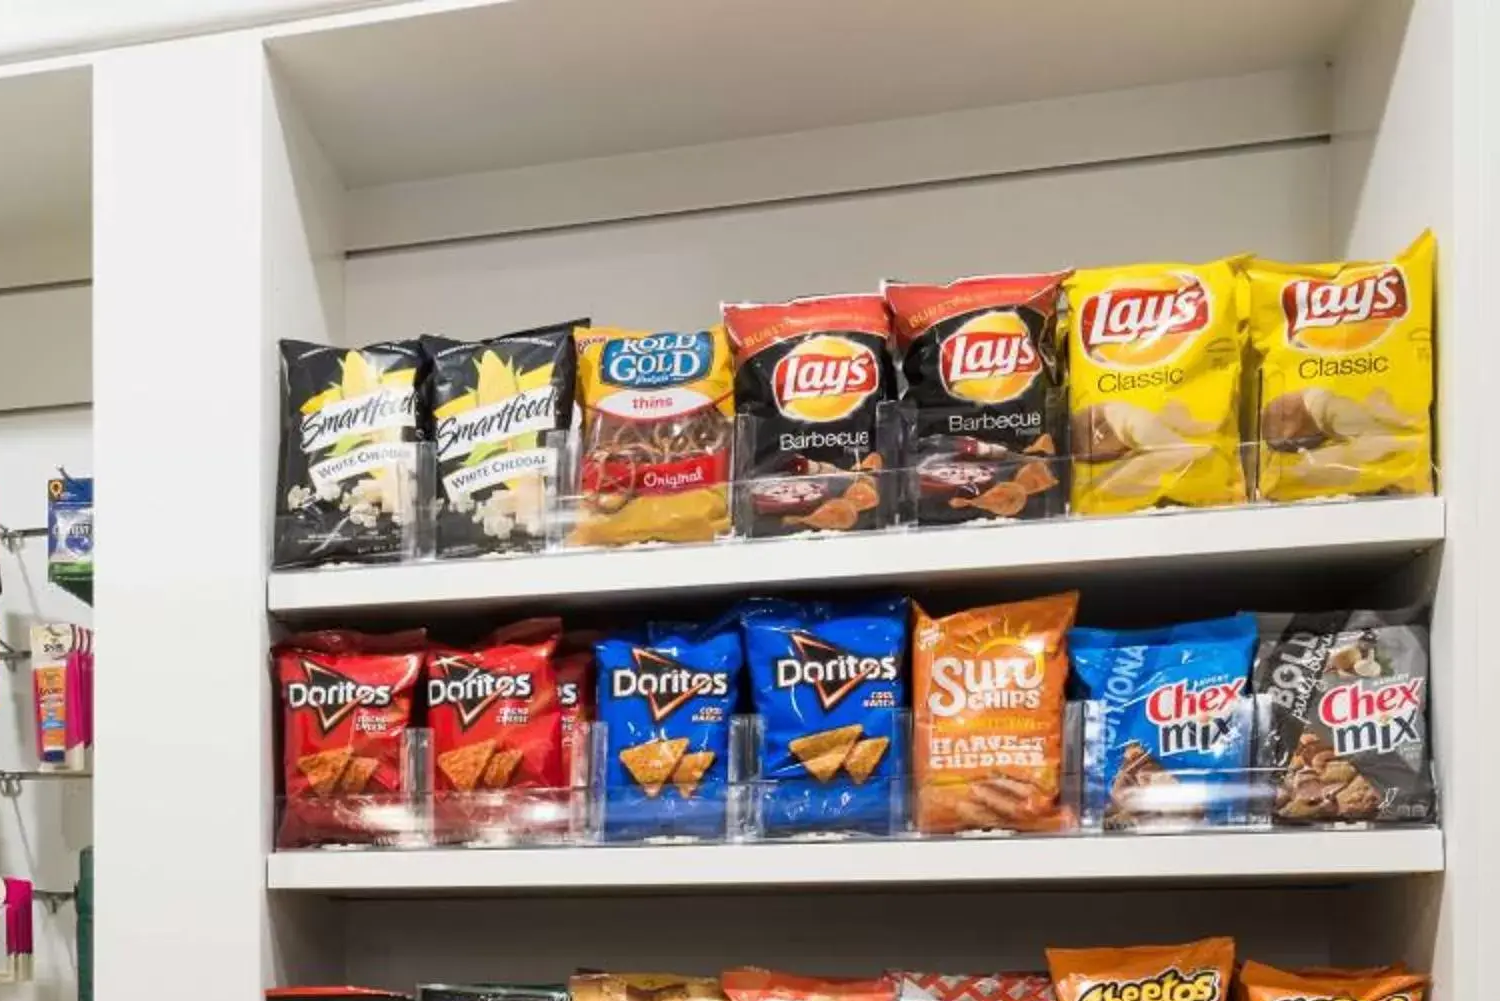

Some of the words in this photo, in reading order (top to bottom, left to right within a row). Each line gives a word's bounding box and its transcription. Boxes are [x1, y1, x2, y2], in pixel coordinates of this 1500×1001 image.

[1088, 280, 1207, 345] Lay's
[1292, 272, 1401, 330] Lay's
[609, 350, 702, 382] GOLD
[947, 330, 1038, 385] Lay's
[1297, 354, 1390, 380] Classic
[782, 352, 872, 401] Lay's
[1096, 365, 1186, 396] Classic
[436, 391, 558, 458] Smartfood
[948, 411, 1042, 433] Barbecue
[779, 430, 870, 452] Barbecue
[452, 466, 491, 489] WHITE
[428, 671, 532, 706] Doritos
[612, 667, 729, 698] Doritos
[776, 654, 898, 689] Doritos
[288, 682, 392, 709] Doritos
[1146, 677, 1248, 723] Chex
[1319, 677, 1426, 724] Chex
